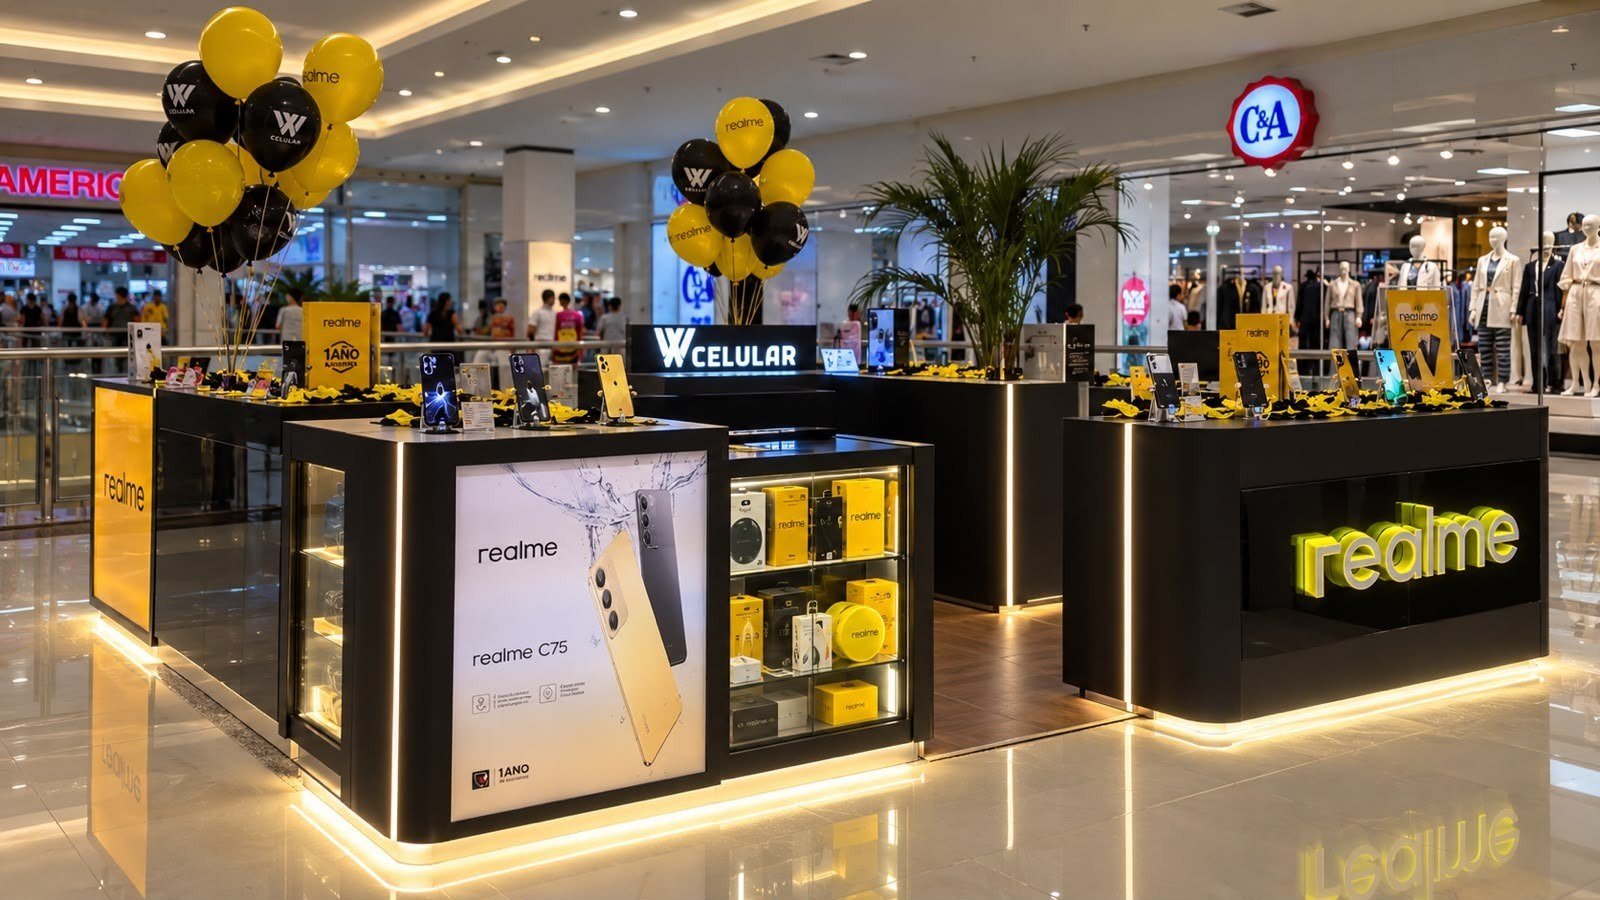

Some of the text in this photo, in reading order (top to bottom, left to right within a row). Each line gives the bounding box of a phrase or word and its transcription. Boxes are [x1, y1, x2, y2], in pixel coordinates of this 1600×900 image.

[725, 117, 764, 132] realme
[1240, 100, 1293, 144] C&A
[676, 224, 712, 241] realme
[323, 317, 361, 328] realme
[691, 345, 796, 367] CELULAR
[103, 472, 145, 512] realme
[778, 519, 805, 530] realme
[848, 511, 881, 523] realme
[478, 540, 558, 564] realme
[1291, 501, 1520, 599] realme
[851, 628, 880, 639] realme
[472, 640, 568, 667] realme C75
